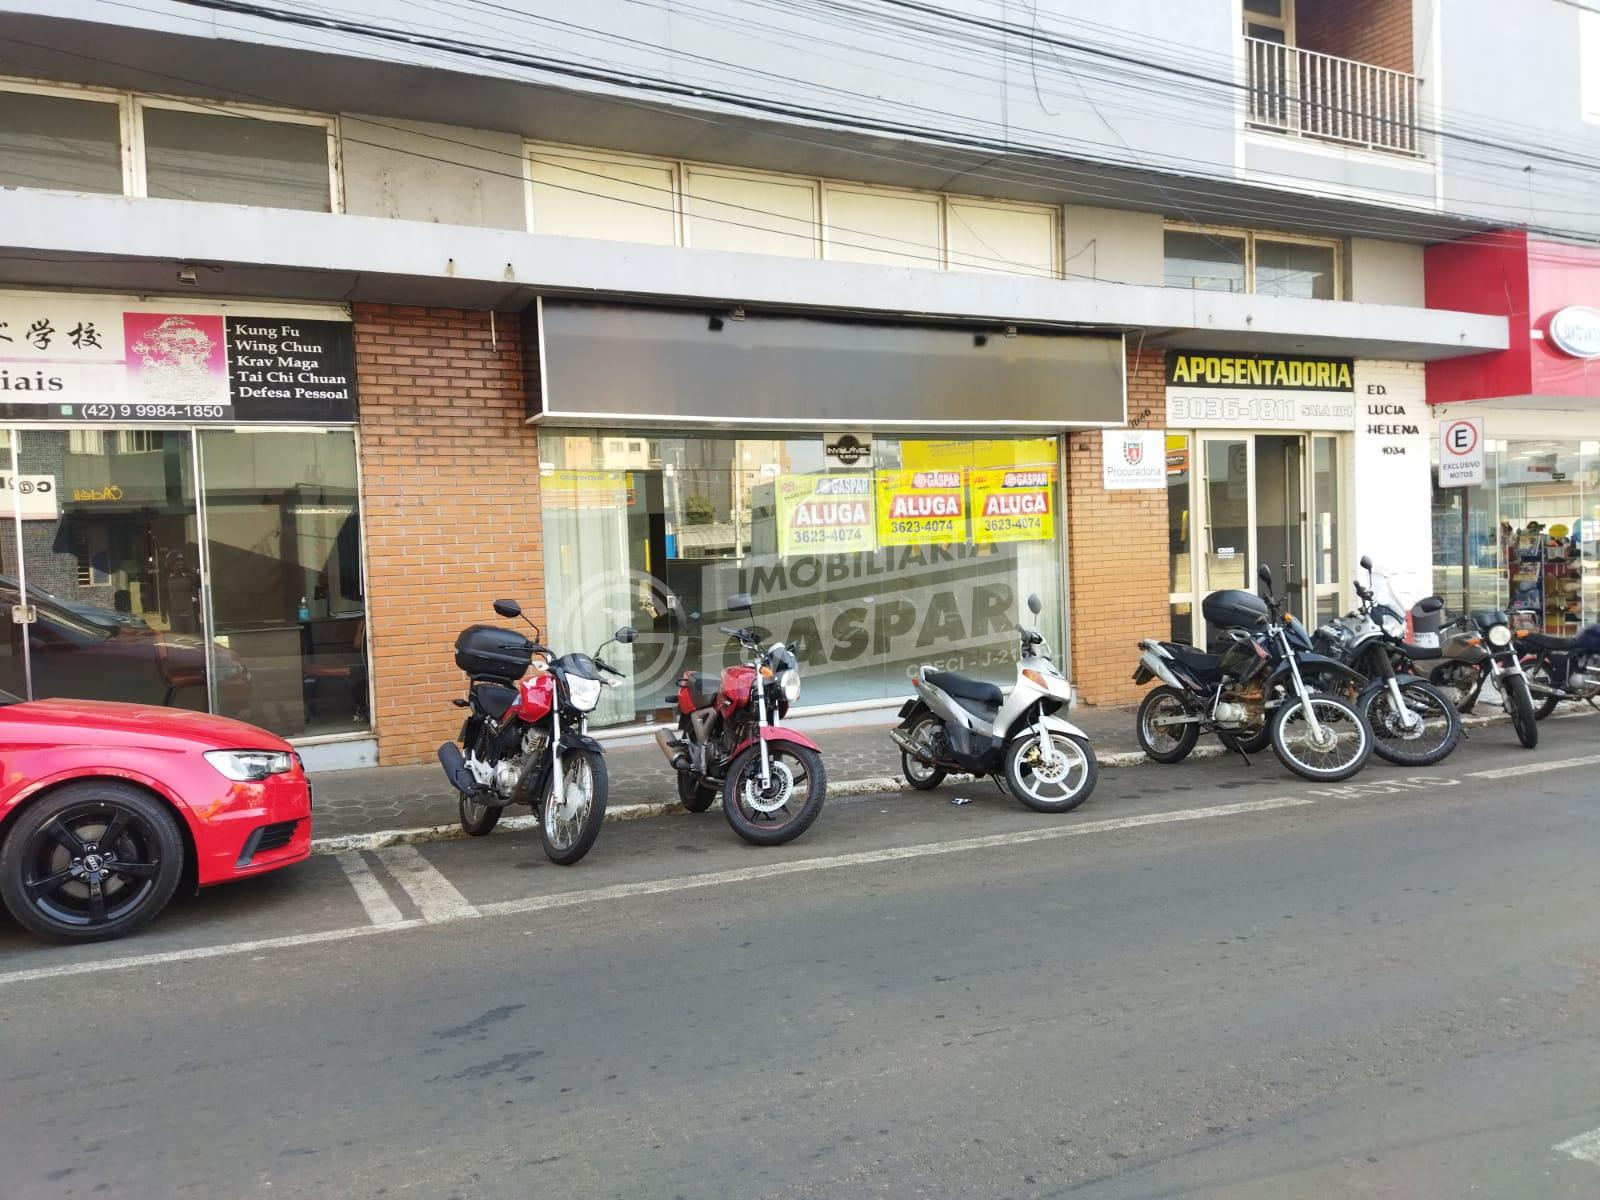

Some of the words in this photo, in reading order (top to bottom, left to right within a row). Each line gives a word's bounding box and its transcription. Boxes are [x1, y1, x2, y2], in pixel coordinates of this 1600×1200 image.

[235, 324, 278, 339] Kung
[281, 326, 300, 337] Fu
[235, 340, 278, 355] Wing
[281, 341, 323, 353] Chun
[236, 355, 274, 367] Krav
[278, 357, 319, 371] Maga
[237, 371, 263, 382] Tai
[266, 371, 294, 383] Chi
[297, 372, 347, 384] Chuan
[1172, 356, 1353, 388] APOSENTADORIA
[238, 386, 291, 398] Defesa
[295, 388, 348, 399] Pessoal
[82, 404, 115, 419] (42)
[120, 405, 131, 417] 9
[136, 405, 223, 417] 9984-1850
[1172, 396, 1295, 421] 3036-1811
[1367, 404, 1406, 415] LUCIA
[1367, 424, 1419, 435] HELENA
[1455, 429, 1467, 448] E
[1382, 446, 1406, 456] 1034
[1107, 466, 1161, 477] Procuradoria
[1443, 461, 1480, 471] EXCLUSIVO
[927, 473, 960, 488] GASPAR
[1017, 472, 1047, 487] GASPAR
[1449, 471, 1473, 479] MOTOS
[832, 478, 868, 493] GASPAR
[893, 496, 959, 517] ALUGA
[986, 493, 1047, 515] ALUGA
[796, 503, 866, 525] ALUGA
[891, 519, 953, 533] 3623-4074
[985, 518, 1040, 531] 3623-4074
[794, 528, 861, 543] 3623-4074
